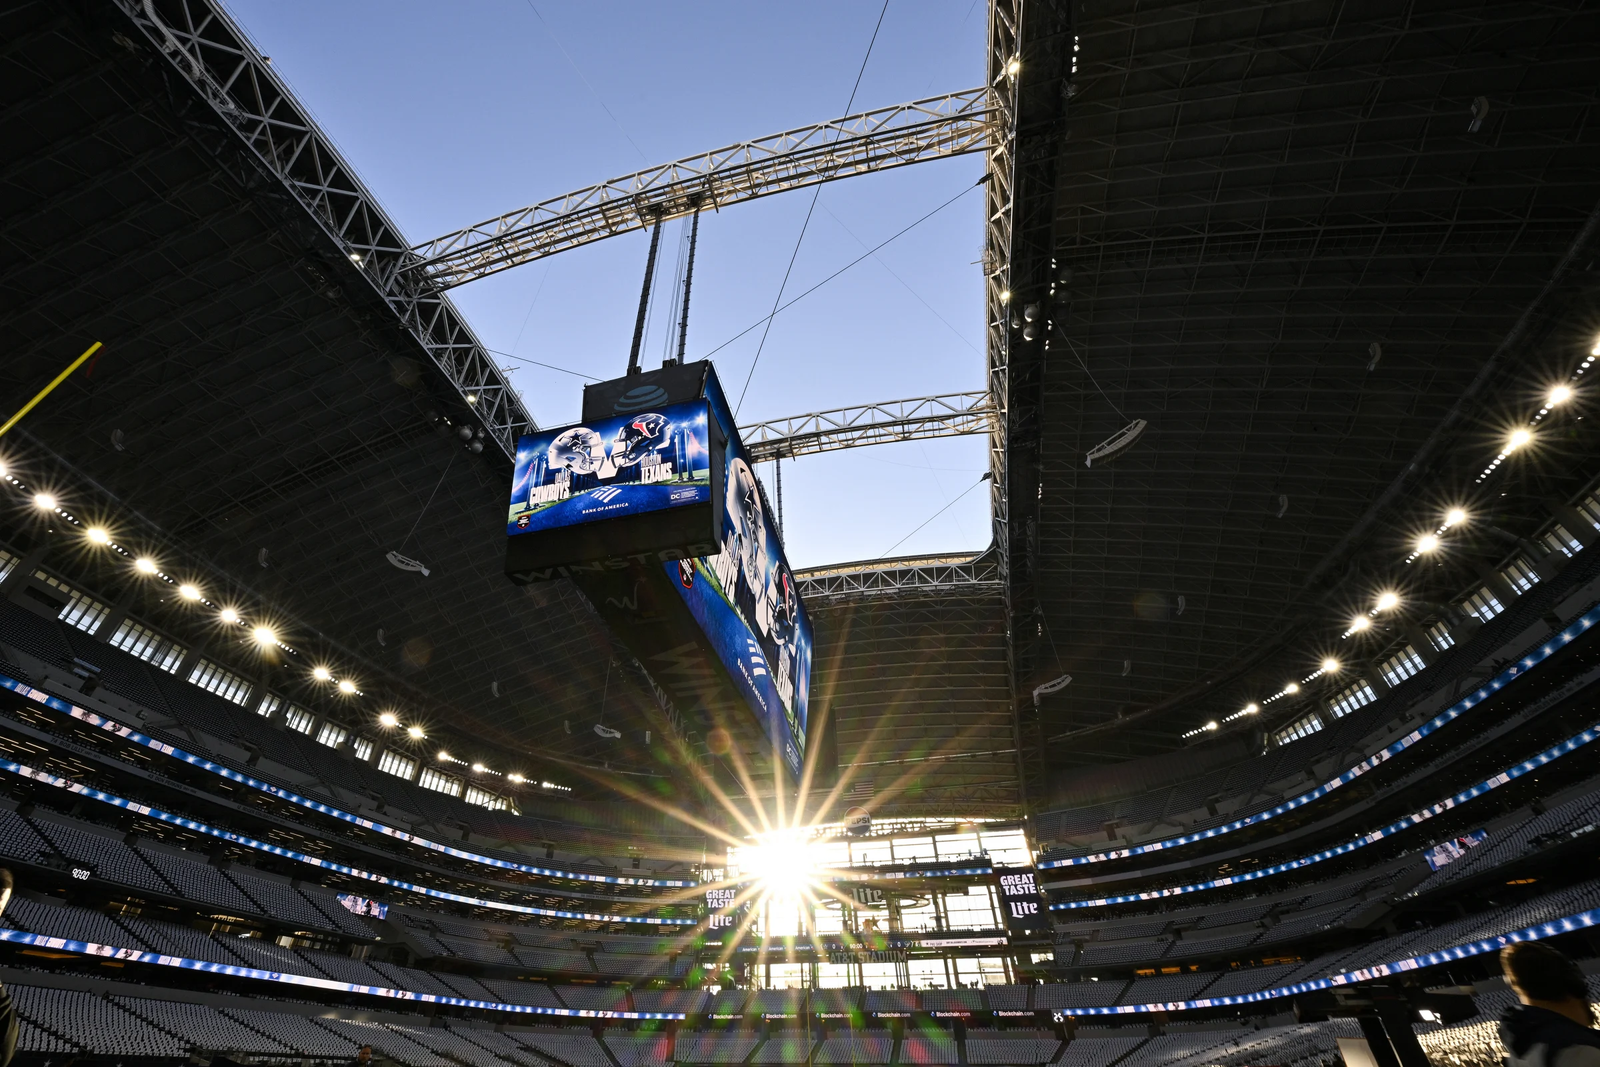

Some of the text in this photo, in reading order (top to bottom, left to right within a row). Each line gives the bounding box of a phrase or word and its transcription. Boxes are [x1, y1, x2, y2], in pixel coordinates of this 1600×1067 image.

[641, 462, 672, 484] TEXANS
[530, 482, 570, 504] COWBOYS
[604, 502, 629, 511] AMERICA
[513, 543, 714, 582] WINSTAR
[59, 741, 71, 749] BOB
[71, 745, 84, 753] LILLY
[1000, 873, 1034, 886] GREAT
[705, 889, 736, 899] GREAT
[1003, 883, 1037, 896] TASTE
[706, 899, 735, 908] TASTE
[1009, 901, 1038, 918] Lite
[708, 914, 733, 929] Lite
[830, 950, 907, 964] AT&T STADIUM
